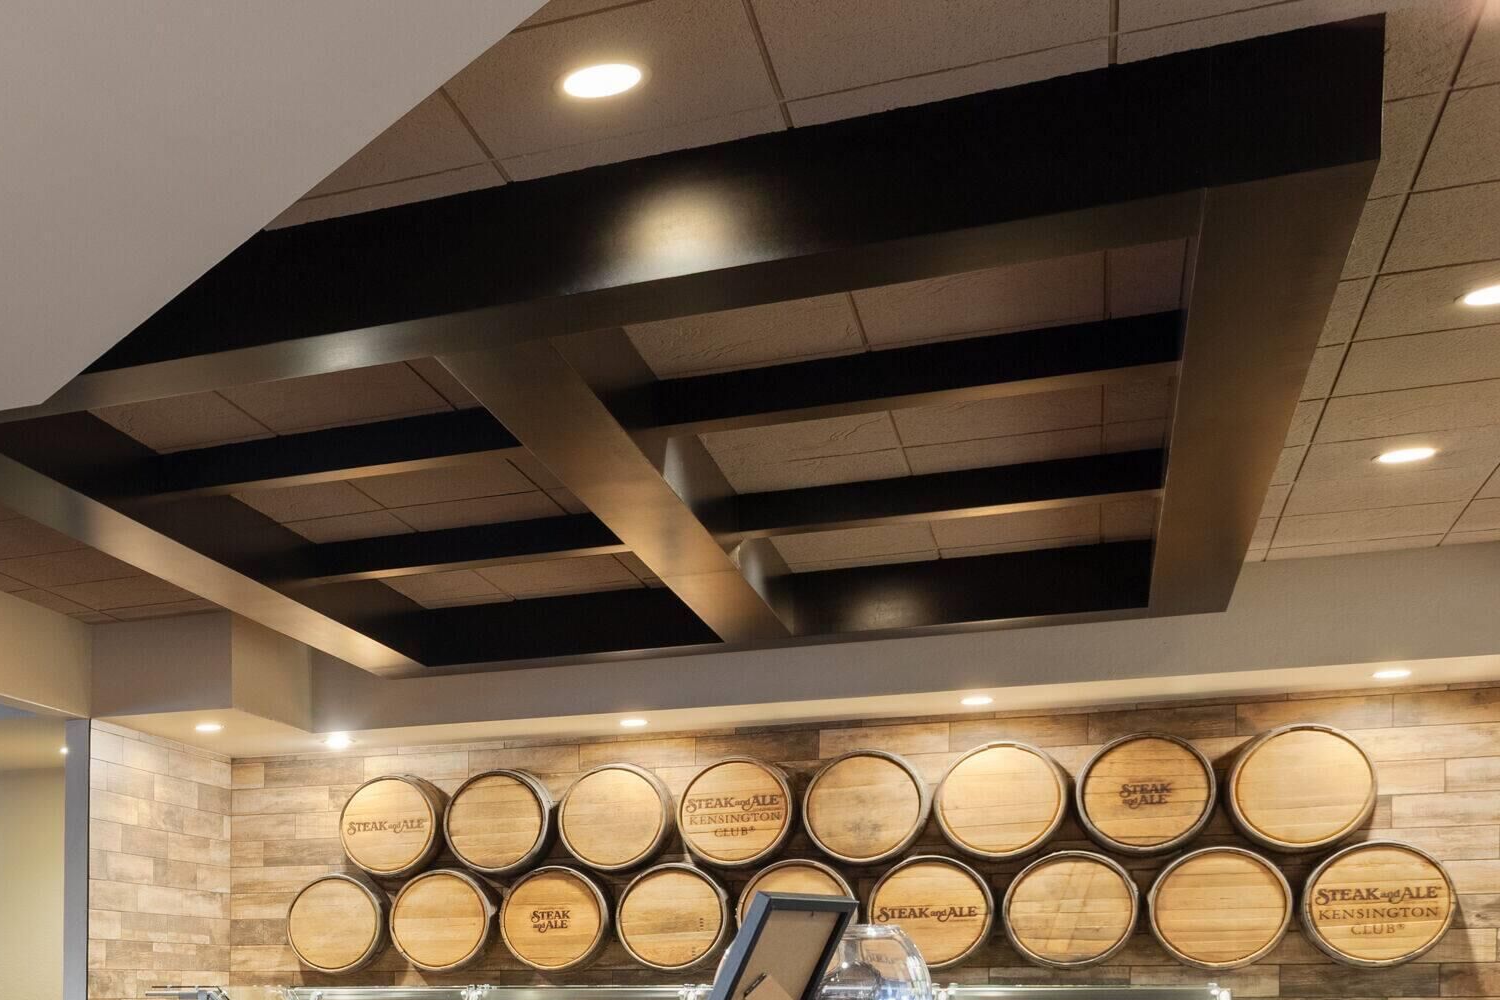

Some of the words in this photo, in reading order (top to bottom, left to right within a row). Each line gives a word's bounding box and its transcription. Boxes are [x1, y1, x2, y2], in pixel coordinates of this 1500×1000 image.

[1119, 783, 1172, 798] STEAK
[685, 797, 735, 813] STEAK
[742, 794, 780, 811] ALE
[1129, 794, 1168, 809] ALE
[689, 811, 780, 826] KENSINGTON
[347, 820, 388, 835] STEAK
[393, 819, 425, 833] ALE
[1315, 887, 1380, 905] STEAK
[1388, 886, 1438, 904] ALE
[531, 910, 570, 923] STEAK
[877, 907, 930, 922] STEAK
[937, 906, 978, 922] ALE
[1318, 906, 1439, 920] KENSINGTON
[538, 919, 568, 933] ALE
